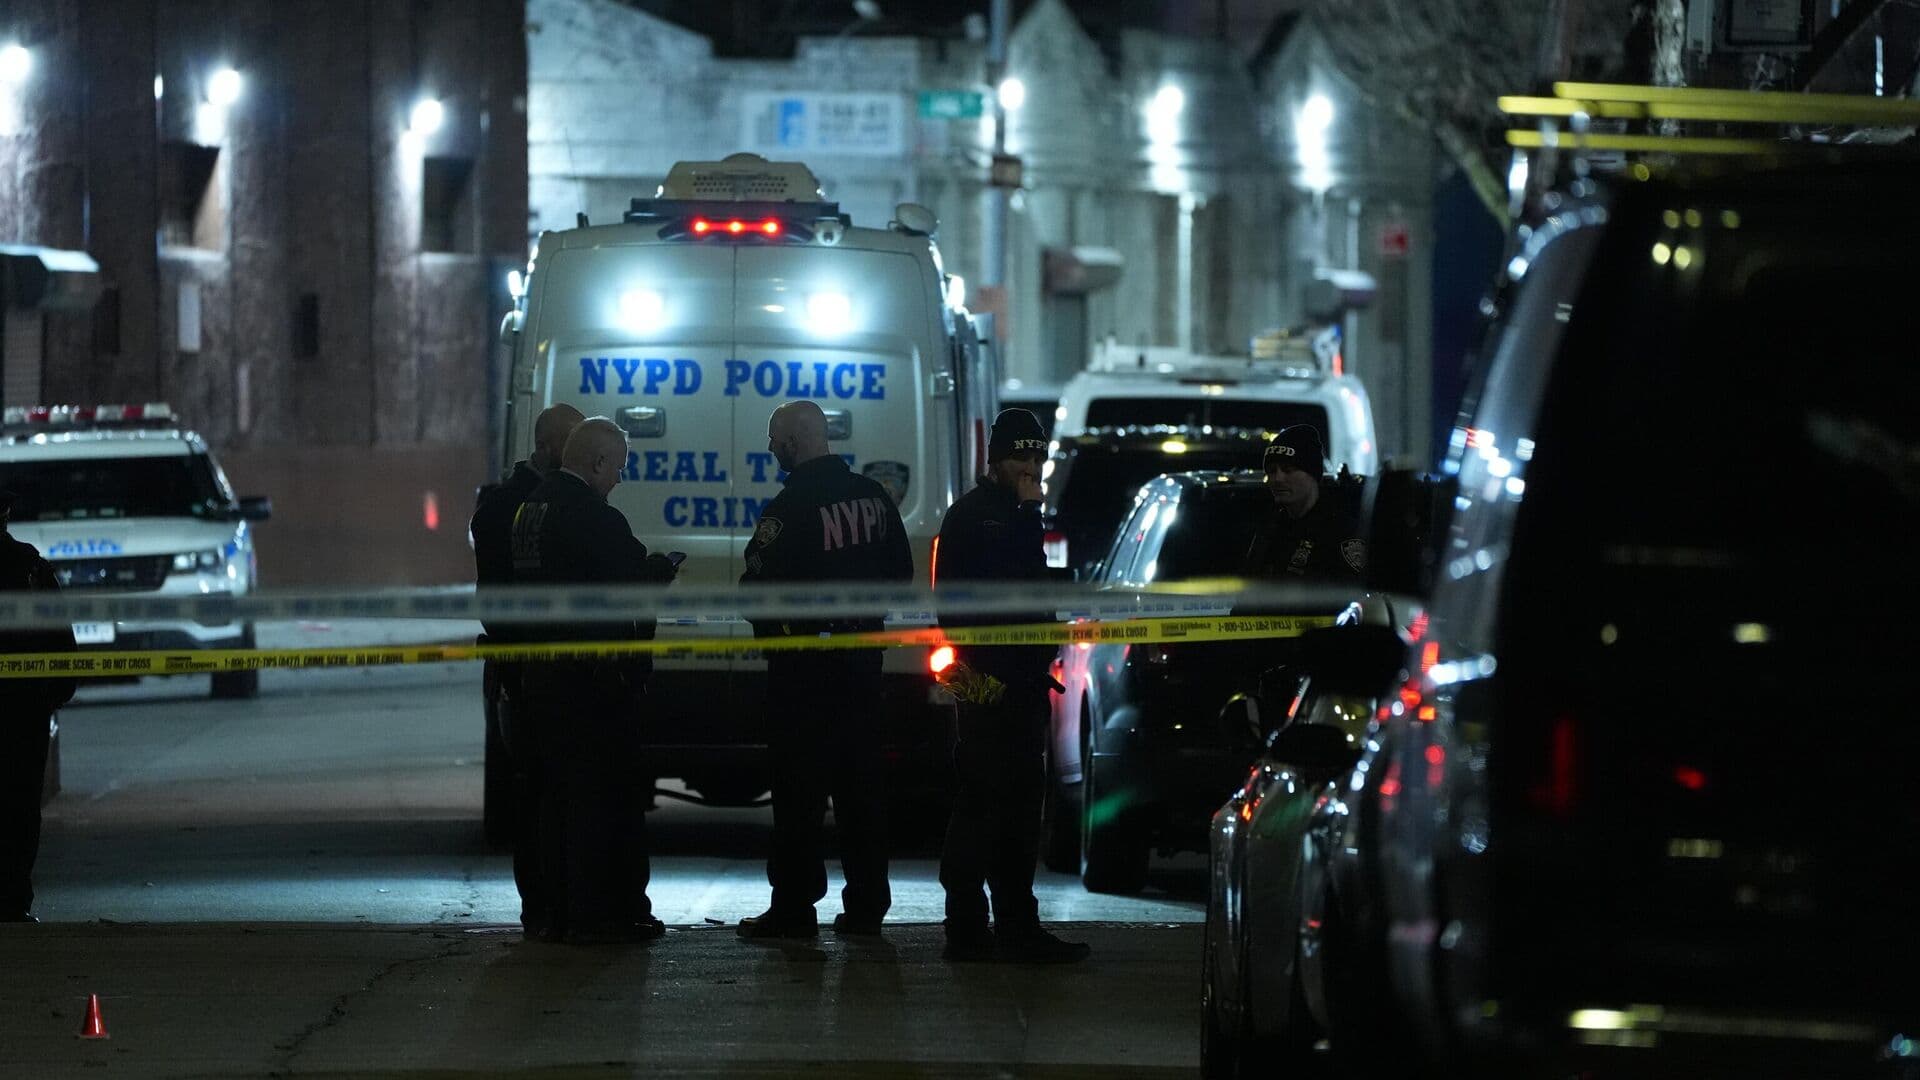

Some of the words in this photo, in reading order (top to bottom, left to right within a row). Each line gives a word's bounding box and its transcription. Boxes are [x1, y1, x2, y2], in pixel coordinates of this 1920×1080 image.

[579, 358, 701, 395] NYPD
[724, 360, 886, 400] POLICE
[1014, 438, 1048, 451] NYPD
[621, 452, 726, 482] REAL
[664, 497, 770, 528] CRIM
[819, 498, 888, 551] NYPD
[23, 660, 45, 672] (8477)
[49, 659, 70, 671] CRIME
[73, 658, 94, 671] SCENE
[102, 658, 112, 670] DO
[113, 658, 126, 670] NOT
[128, 657, 151, 670] CROSS
